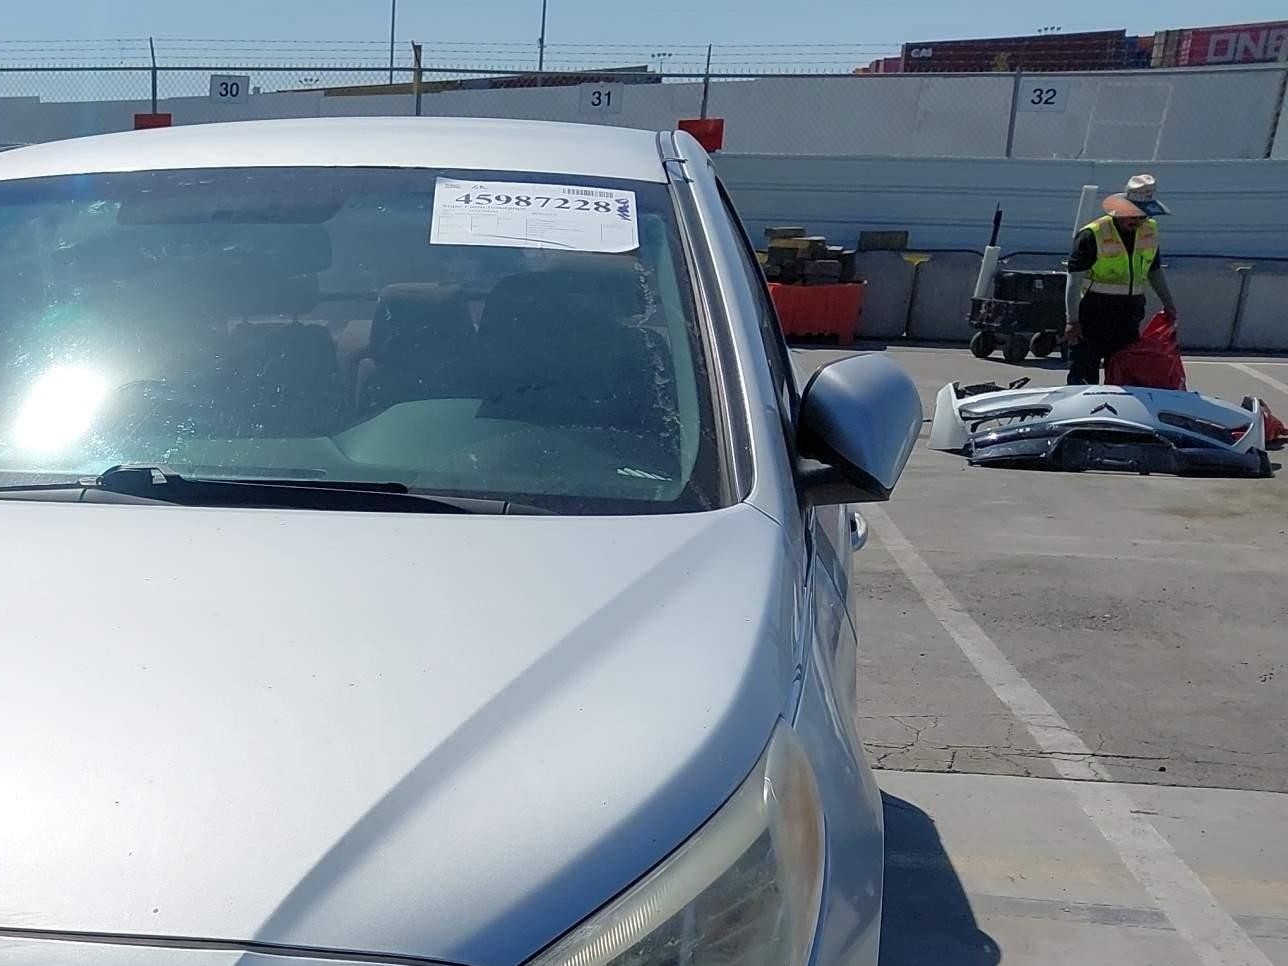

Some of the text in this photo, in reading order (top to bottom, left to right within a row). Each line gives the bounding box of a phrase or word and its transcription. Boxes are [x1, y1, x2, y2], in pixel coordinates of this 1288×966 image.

[219, 82, 239, 98] 30
[1030, 88, 1057, 105] 32
[591, 91, 611, 107] 31
[455, 193, 611, 213] 45987228
